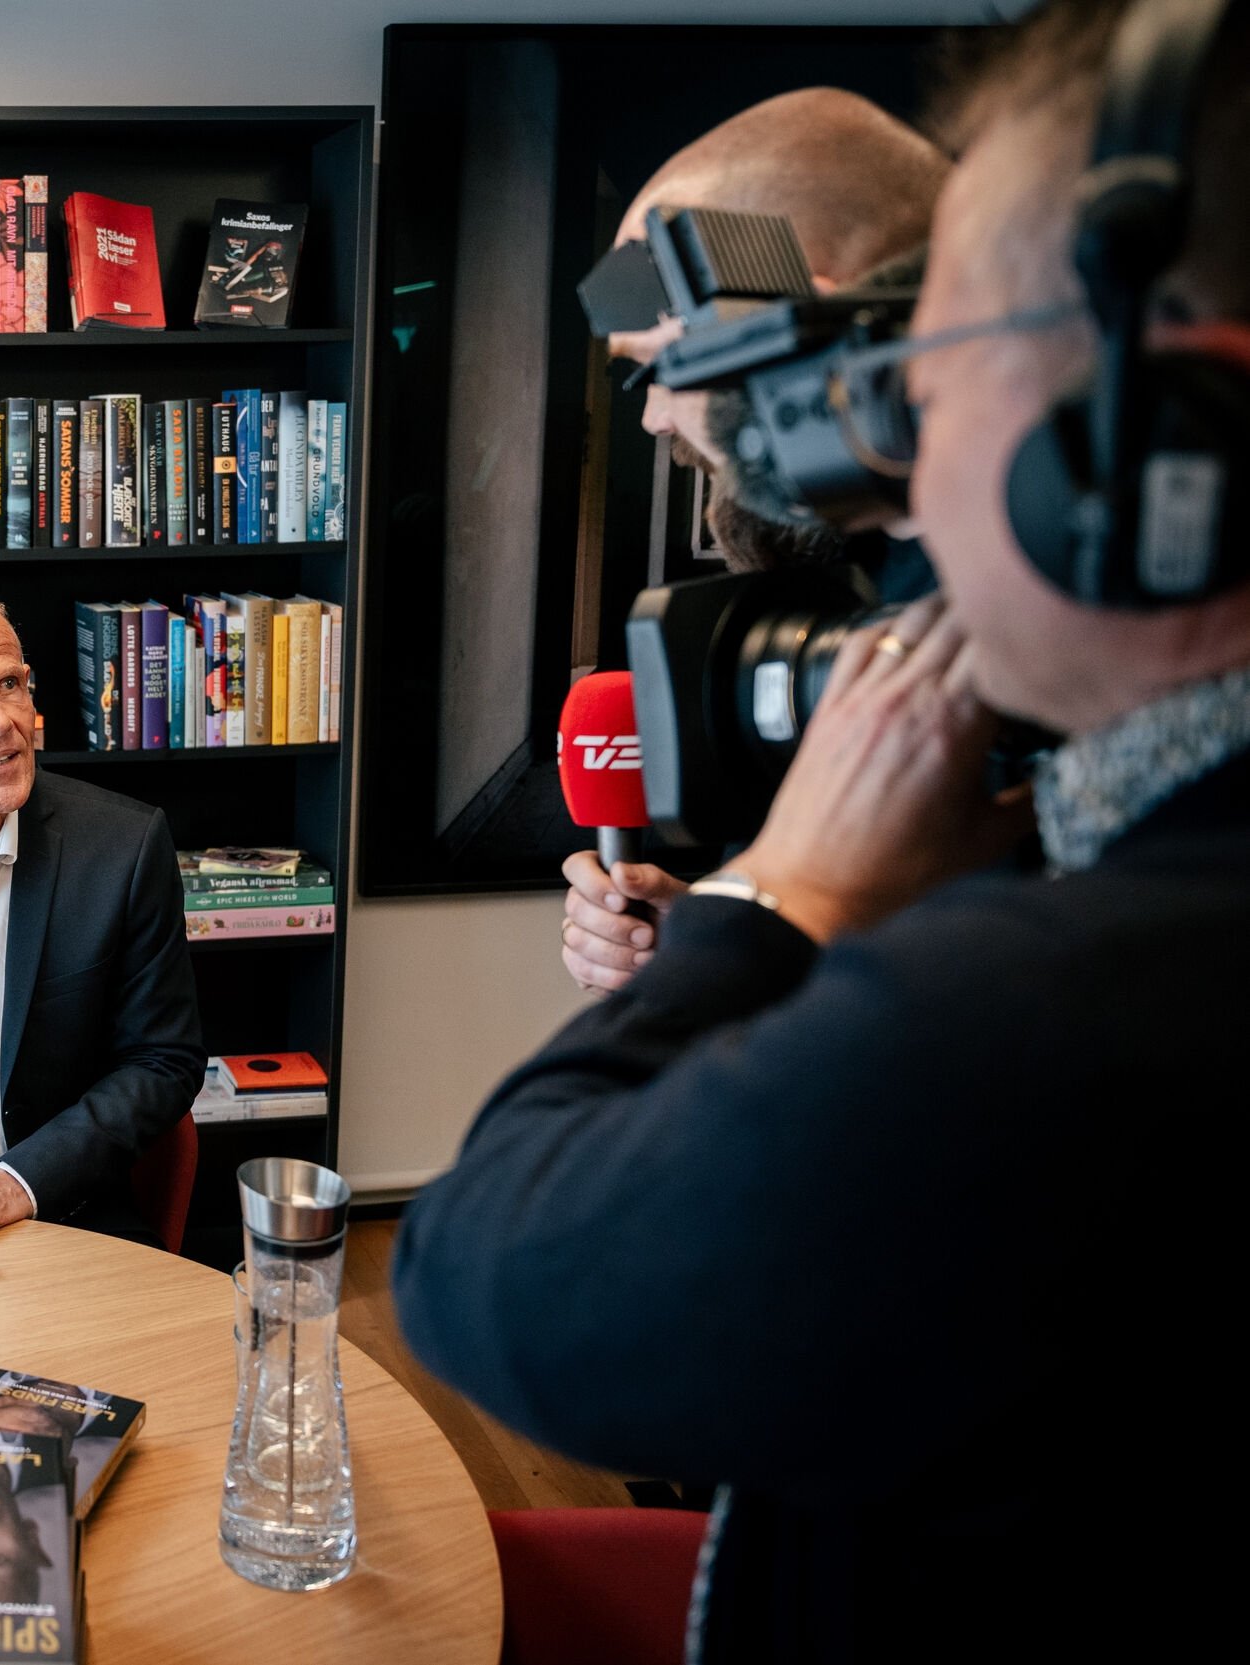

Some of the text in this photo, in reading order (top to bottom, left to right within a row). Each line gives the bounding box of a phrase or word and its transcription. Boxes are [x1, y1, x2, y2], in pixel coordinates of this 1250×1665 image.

[6, 186, 16, 267] OLGA RAVN MIT
[221, 217, 294, 232] krimianbefalinger
[246, 212, 271, 222] Saxos
[96, 227, 108, 261] 2021
[107, 230, 137, 246] Sådan
[107, 243, 134, 257] læser
[108, 253, 119, 264] vi
[61, 420, 71, 467] SATANS
[173, 409, 183, 444] SARA
[221, 416, 230, 453] UTHAUG
[38, 437, 47, 474] HJERNEN
[86, 451, 95, 468] Den
[295, 415, 306, 504] LUCINDA RILEY
[331, 414, 342, 484] FRANK VENDER HJEM
[38, 475, 46, 491] BAG
[61, 470, 71, 523] SOMMER
[149, 445, 157, 524] SKYGGEDANSEREN
[312, 448, 321, 518] GRUNDVOLD
[38, 492, 46, 528] ASTRALIS
[112, 483, 123, 522] HJERTE
[127, 625, 135, 649] LOTTE
[210, 878, 248, 888] Vegansk
[271, 894, 297, 902] WORLD
[58, 1401, 117, 1422] LARS
